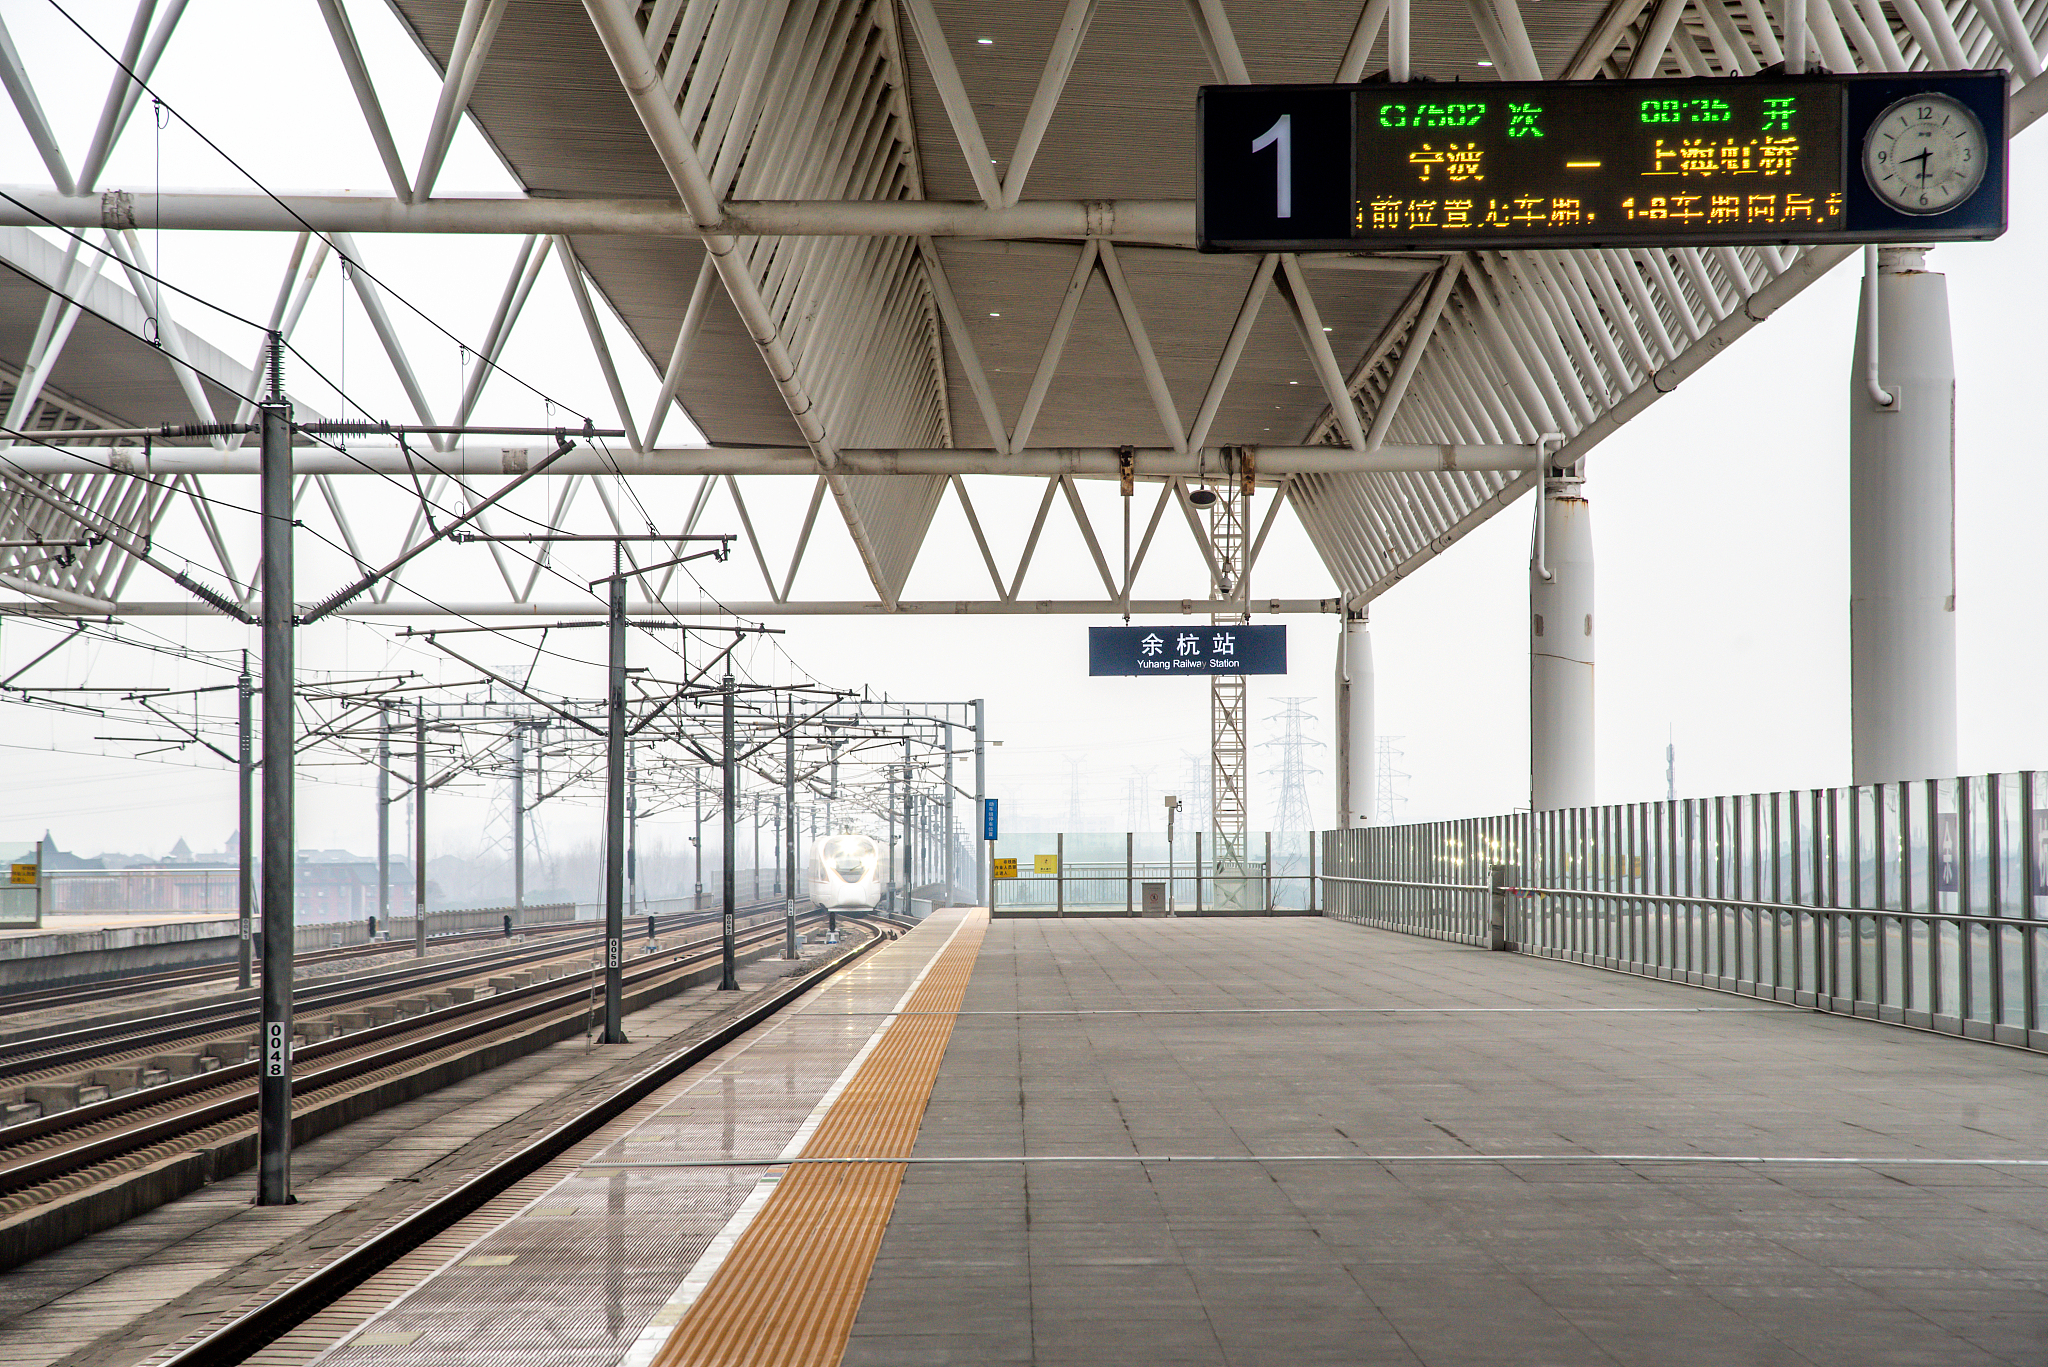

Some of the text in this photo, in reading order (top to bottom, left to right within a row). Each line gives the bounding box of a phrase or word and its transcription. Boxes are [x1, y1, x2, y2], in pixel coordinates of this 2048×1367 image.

[1508, 103, 1544, 137] 次
[1641, 97, 1797, 131] 08:35 开
[1917, 106, 1932, 120] 12
[1251, 114, 1292, 218] 1
[1409, 142, 1485, 182] 宁波
[1641, 136, 1800, 177] 上海虹桥
[1877, 151, 1887, 164] 9
[1963, 148, 1971, 162] 3
[1919, 193, 1928, 206] 6
[1141, 632, 1236, 656] 余杭站
[1137, 659, 1239, 670] Yuhang Railway Station
[270, 1024, 282, 1076] 0048
